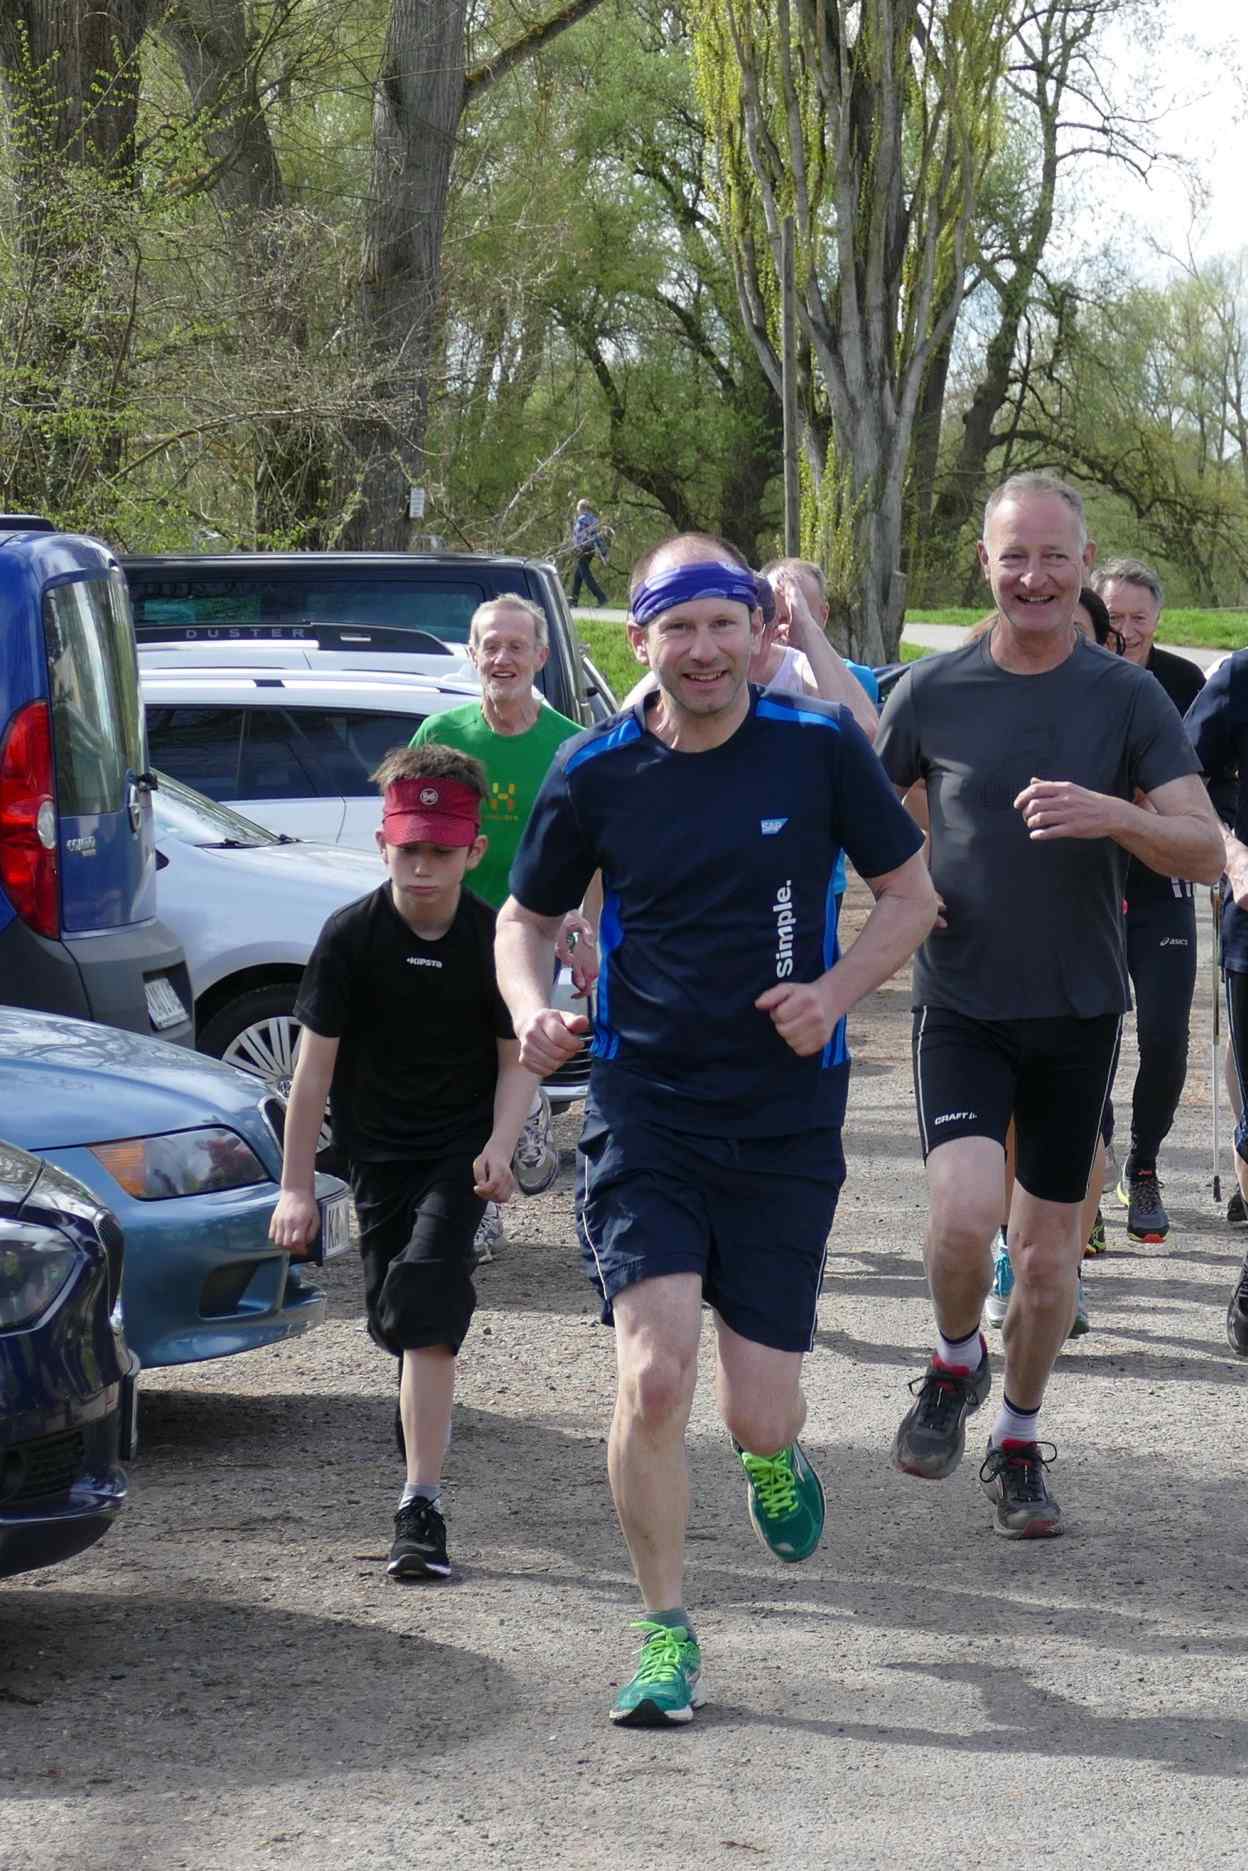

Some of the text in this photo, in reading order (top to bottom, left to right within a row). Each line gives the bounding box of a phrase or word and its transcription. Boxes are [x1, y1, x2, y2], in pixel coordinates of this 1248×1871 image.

[185, 628, 305, 639] DUSTER
[772, 879, 797, 979] Simple.
[934, 1112, 969, 1125] CRAFT
